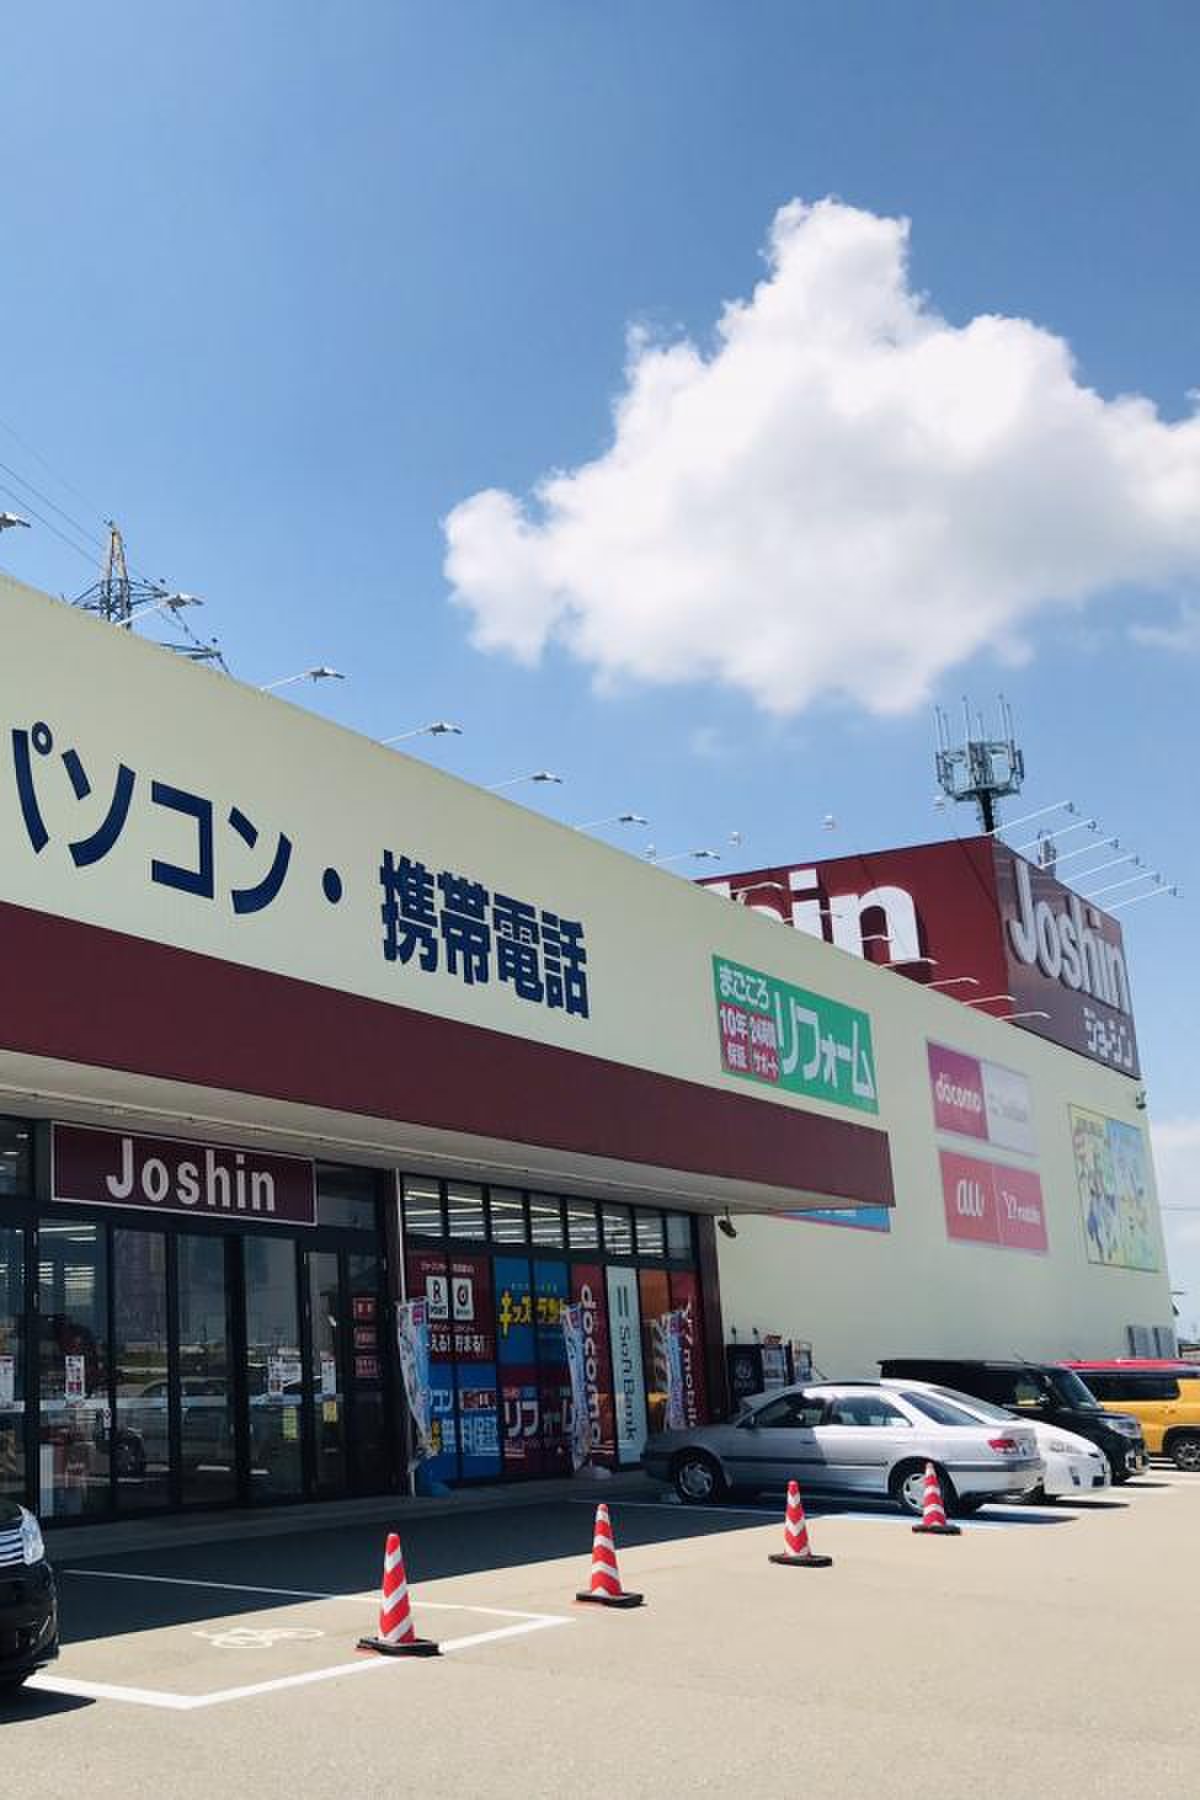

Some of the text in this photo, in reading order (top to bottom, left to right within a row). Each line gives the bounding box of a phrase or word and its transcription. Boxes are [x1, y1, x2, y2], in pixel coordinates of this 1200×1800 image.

[1008, 859, 1131, 1016] Joshin
[775, 992, 876, 1099] リフォーム
[935, 1073, 982, 1114] docomo
[106, 1137, 275, 1212] Joshin
[956, 1179, 985, 1217] au
